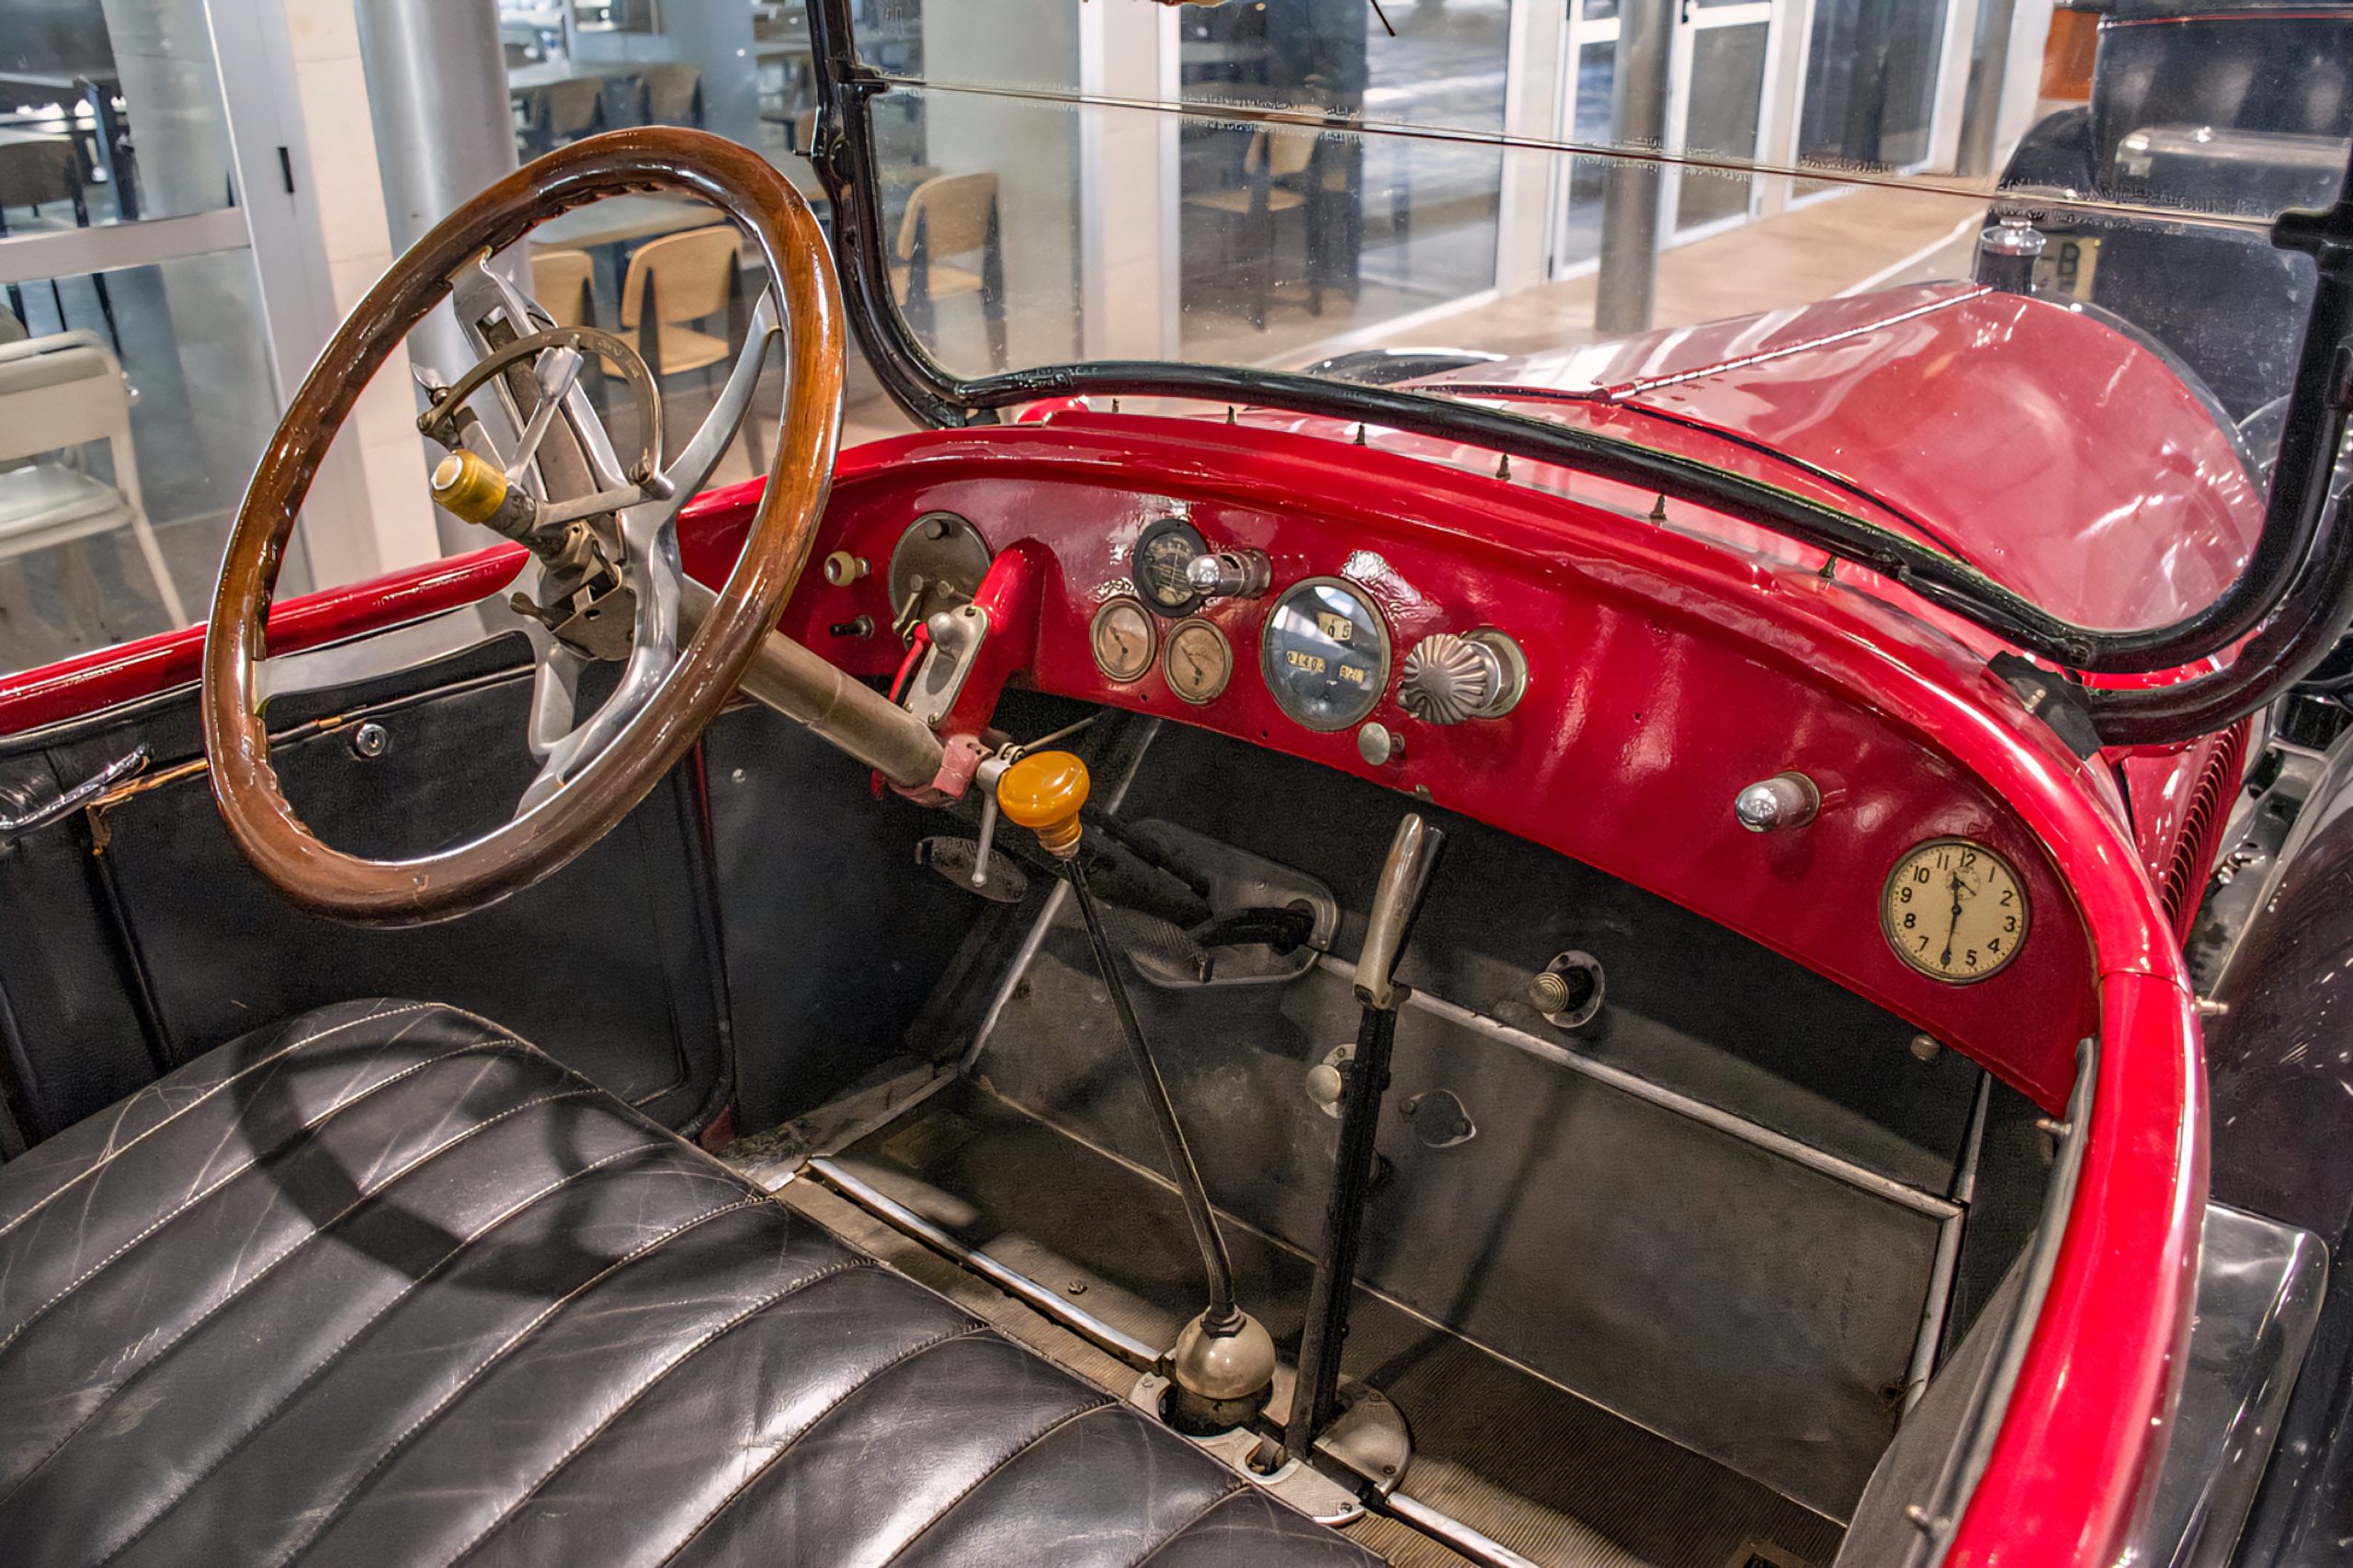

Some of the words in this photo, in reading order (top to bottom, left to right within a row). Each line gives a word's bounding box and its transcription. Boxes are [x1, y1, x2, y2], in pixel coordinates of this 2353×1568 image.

[1937, 851, 1949, 871] 11
[1960, 850, 1976, 868] 12
[1913, 865, 1930, 884] 10
[1989, 866, 1995, 882] 1
[1900, 887, 1913, 903] 9
[2000, 890, 2013, 906] 2
[1904, 913, 1916, 929] 8
[2003, 916, 2016, 933] 3
[1918, 936, 1929, 952] 7
[1986, 937, 2000, 954] 4
[1965, 949, 1977, 966] 5
